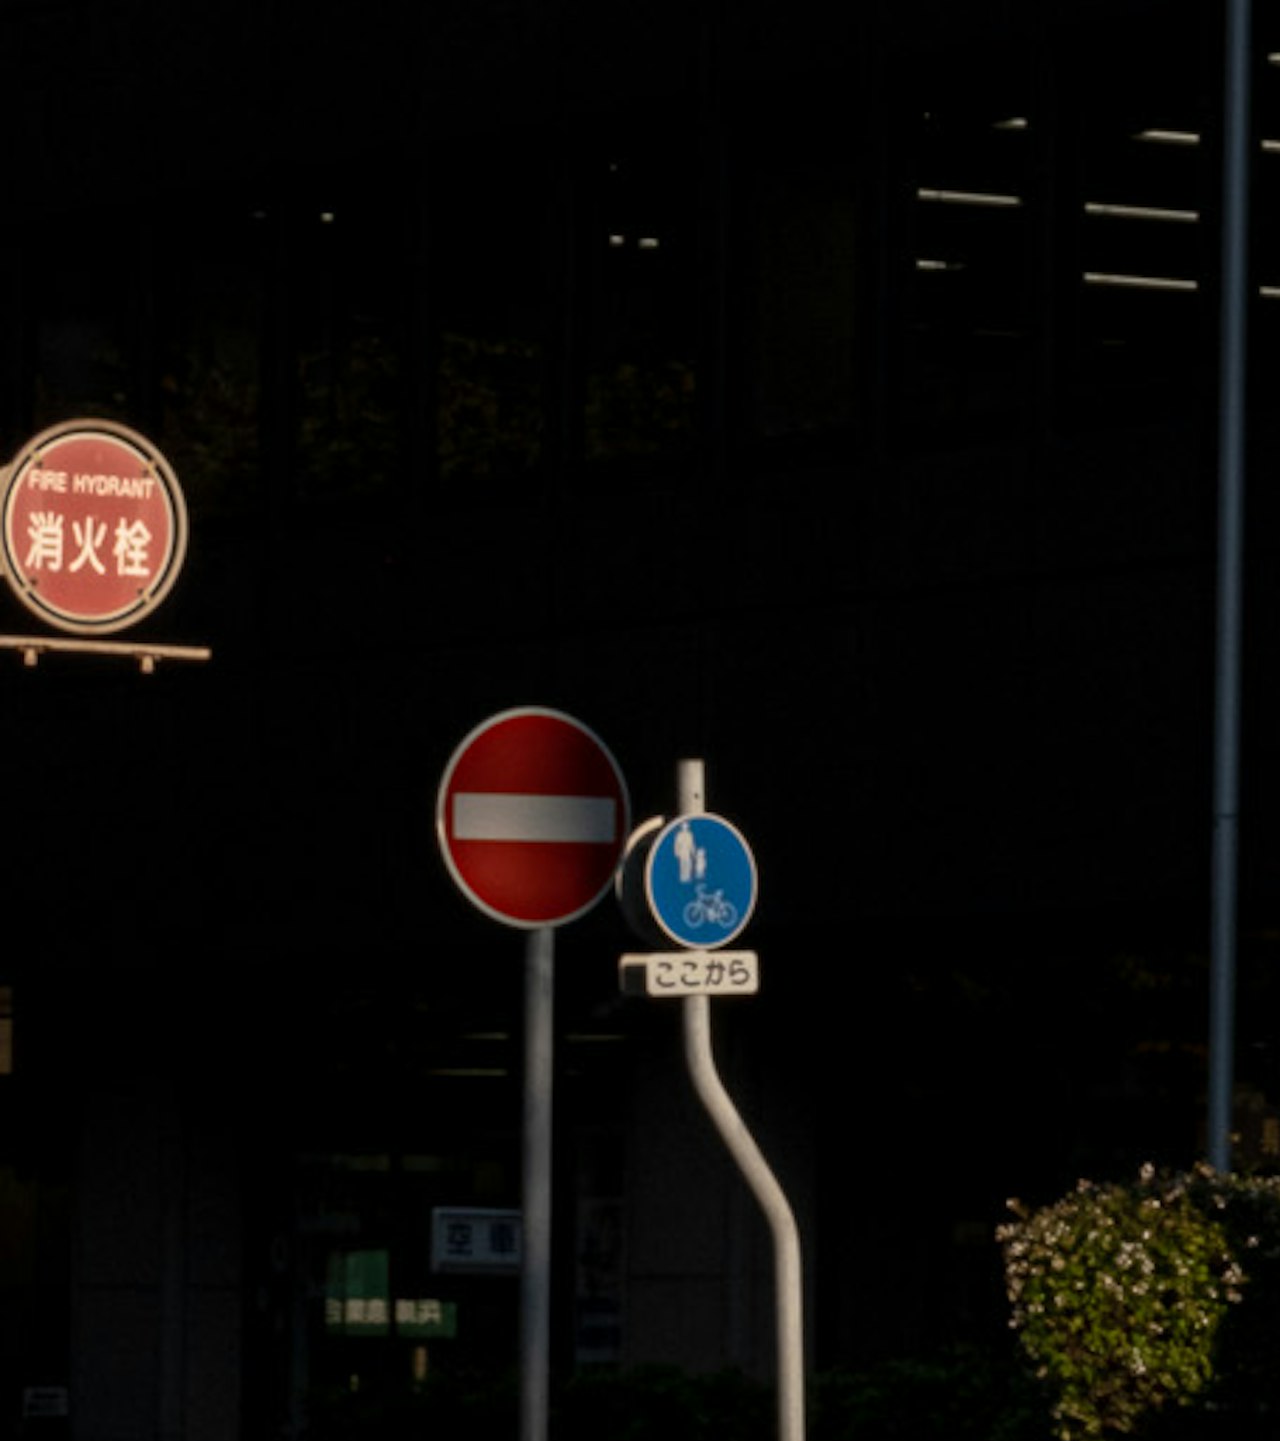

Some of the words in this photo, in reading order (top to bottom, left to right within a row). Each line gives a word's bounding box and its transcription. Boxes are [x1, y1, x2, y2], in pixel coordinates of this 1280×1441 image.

[28, 470, 68, 493] FIRE
[72, 473, 155, 499] HYDRANT
[25, 511, 152, 577] 消火栓
[655, 959, 750, 988] ここから
